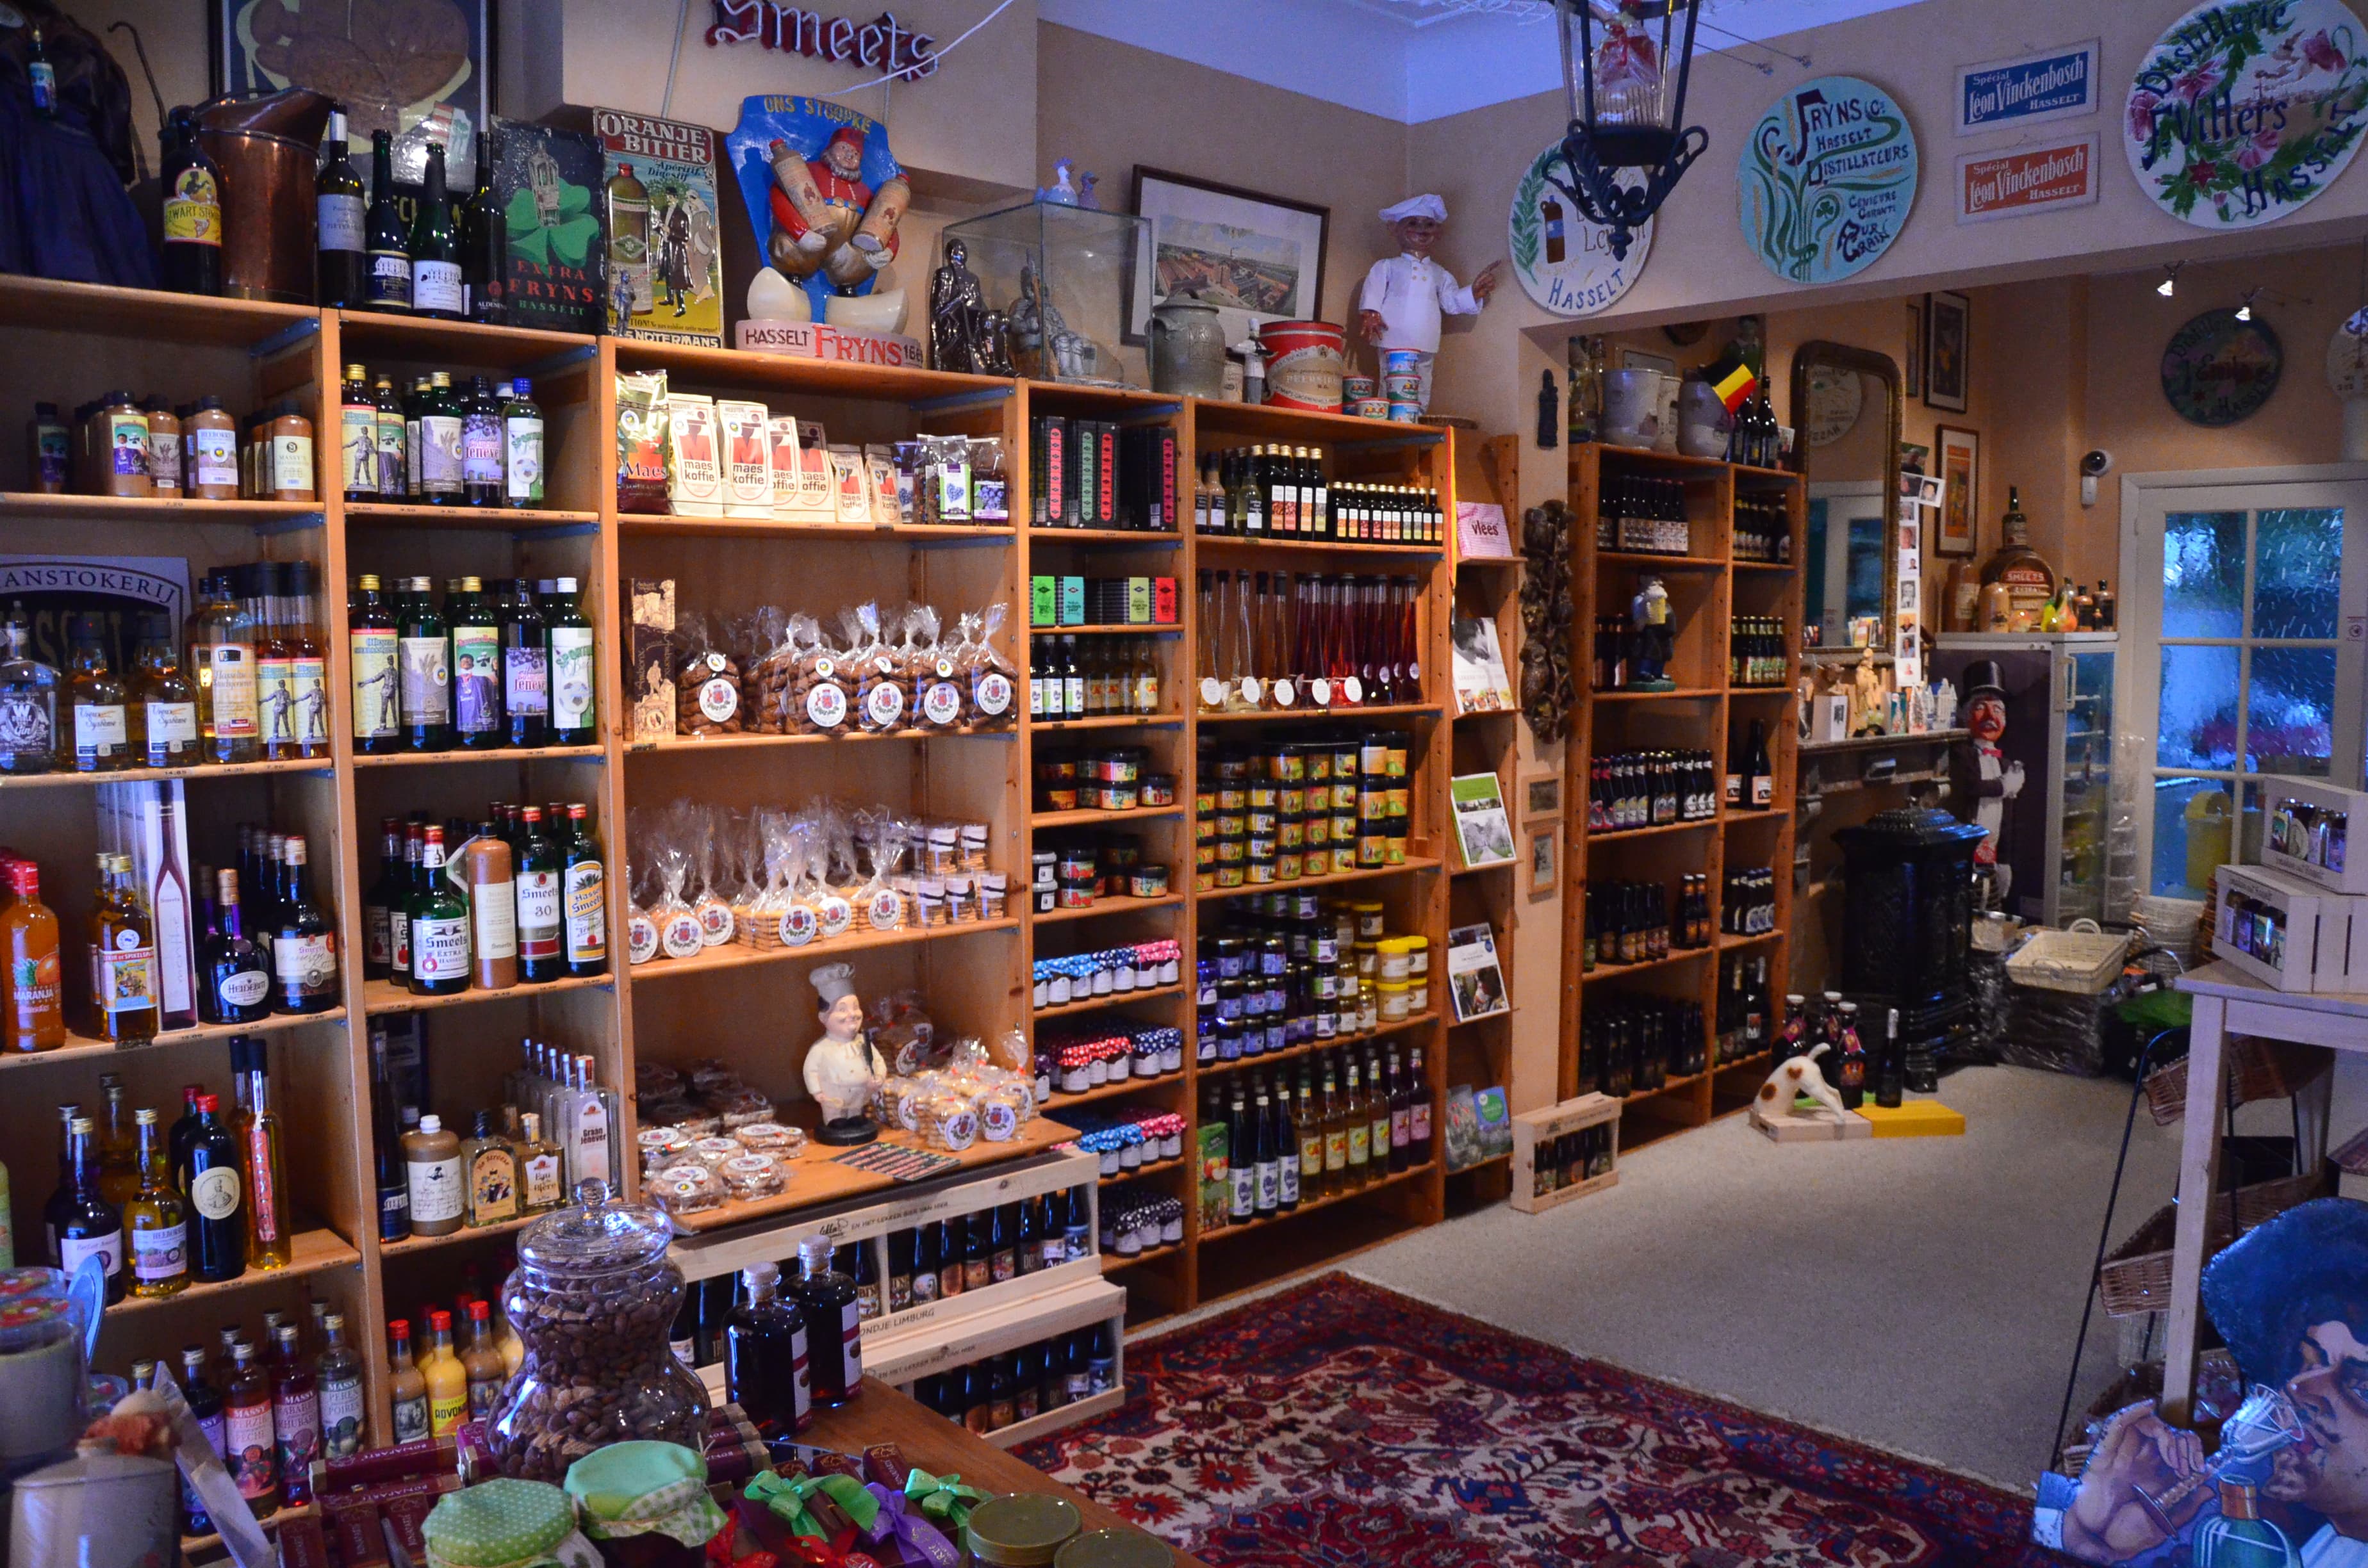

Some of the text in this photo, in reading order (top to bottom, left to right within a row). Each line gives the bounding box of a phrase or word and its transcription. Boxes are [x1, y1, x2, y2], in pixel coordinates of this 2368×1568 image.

[705, 0, 939, 82] Smeets
[2135, 6, 2288, 97] Distillerie
[1996, 54, 2084, 111] Vinckenbosch
[623, 133, 707, 163] BITTER
[2242, 102, 2358, 215] HASSELT
[1996, 147, 2085, 201] Vinckenbosch
[517, 259, 588, 282] EXTRA
[508, 277, 595, 303] FRYNS
[1548, 268, 1624, 310] HASSELT
[518, 299, 585, 316] HASSELT
[745, 329, 810, 347] HASSELT
[812, 324, 903, 366] FRYNS
[623, 459, 666, 480] Maes
[684, 459, 712, 471] maes
[732, 462, 763, 474] maes
[684, 469, 715, 482] koffie
[732, 472, 764, 485] koffie
[773, 471, 793, 480] aes
[802, 481, 826, 493] offie
[1471, 519, 1500, 536] vlees
[522, 887, 559, 899] Smeets
[574, 888, 602, 903] Hasse
[535, 904, 552, 917] 30
[425, 937, 467, 950] Smeets
[14, 991, 54, 1001] MARANJA
[582, 1128, 602, 1138] Graan
[580, 1135, 605, 1146] Jenever
[859, 1307, 935, 1337] ONDJE LIMBURG
[328, 1380, 359, 1391] MASSY
[284, 1391, 313, 1404] MASSY
[234, 1407, 264, 1417] MASSY
[201, 1418, 217, 1428] SSY
